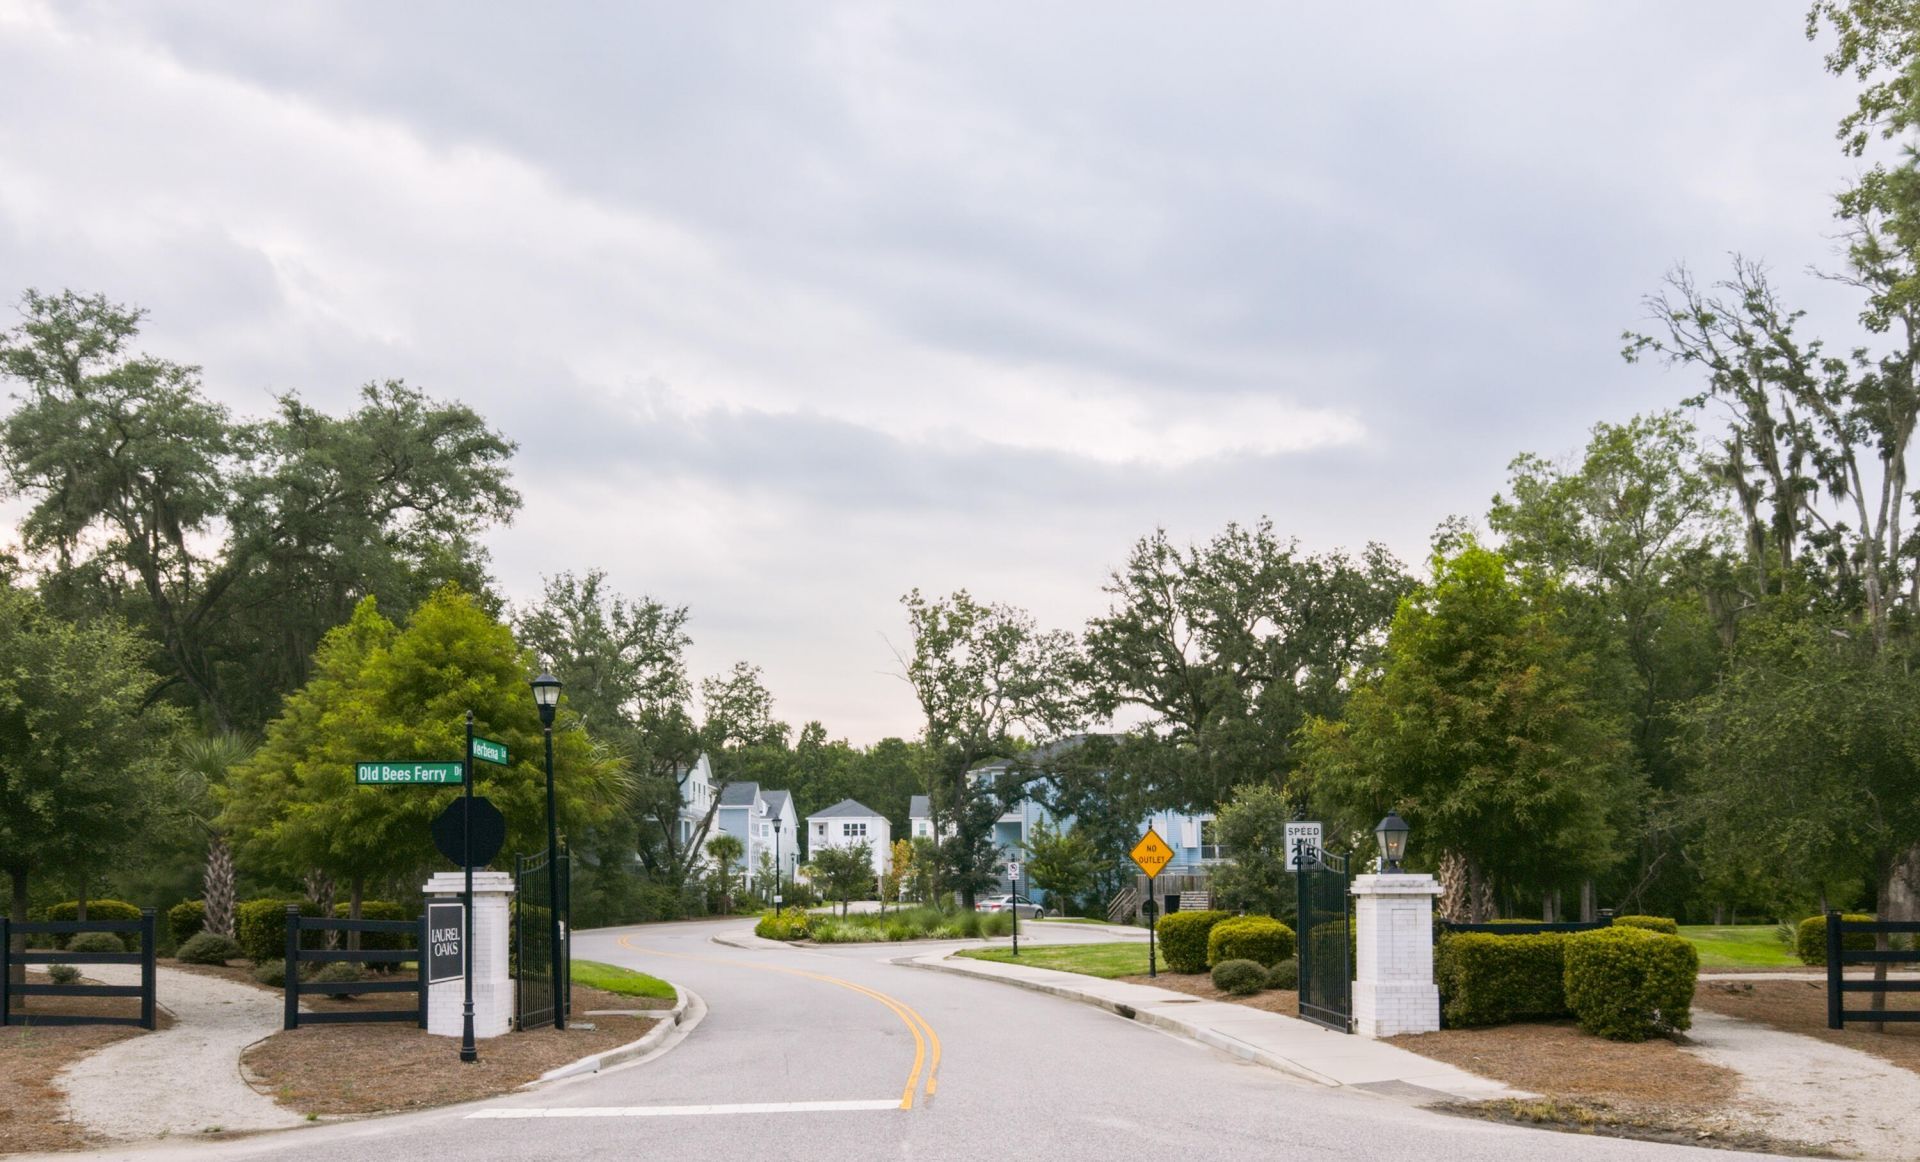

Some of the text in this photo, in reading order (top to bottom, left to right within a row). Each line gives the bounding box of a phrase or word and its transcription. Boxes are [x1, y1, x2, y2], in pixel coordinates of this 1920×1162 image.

[472, 740, 498, 760] Verbena
[359, 766, 462, 782] Old Bees Ferry Dr
[1288, 827, 1320, 836] SPEED
[1291, 837, 1317, 846] LMIT
[1291, 847, 1317, 865] 25
[432, 928, 460, 943] LAUREL
[434, 942, 458, 957] OAKS
